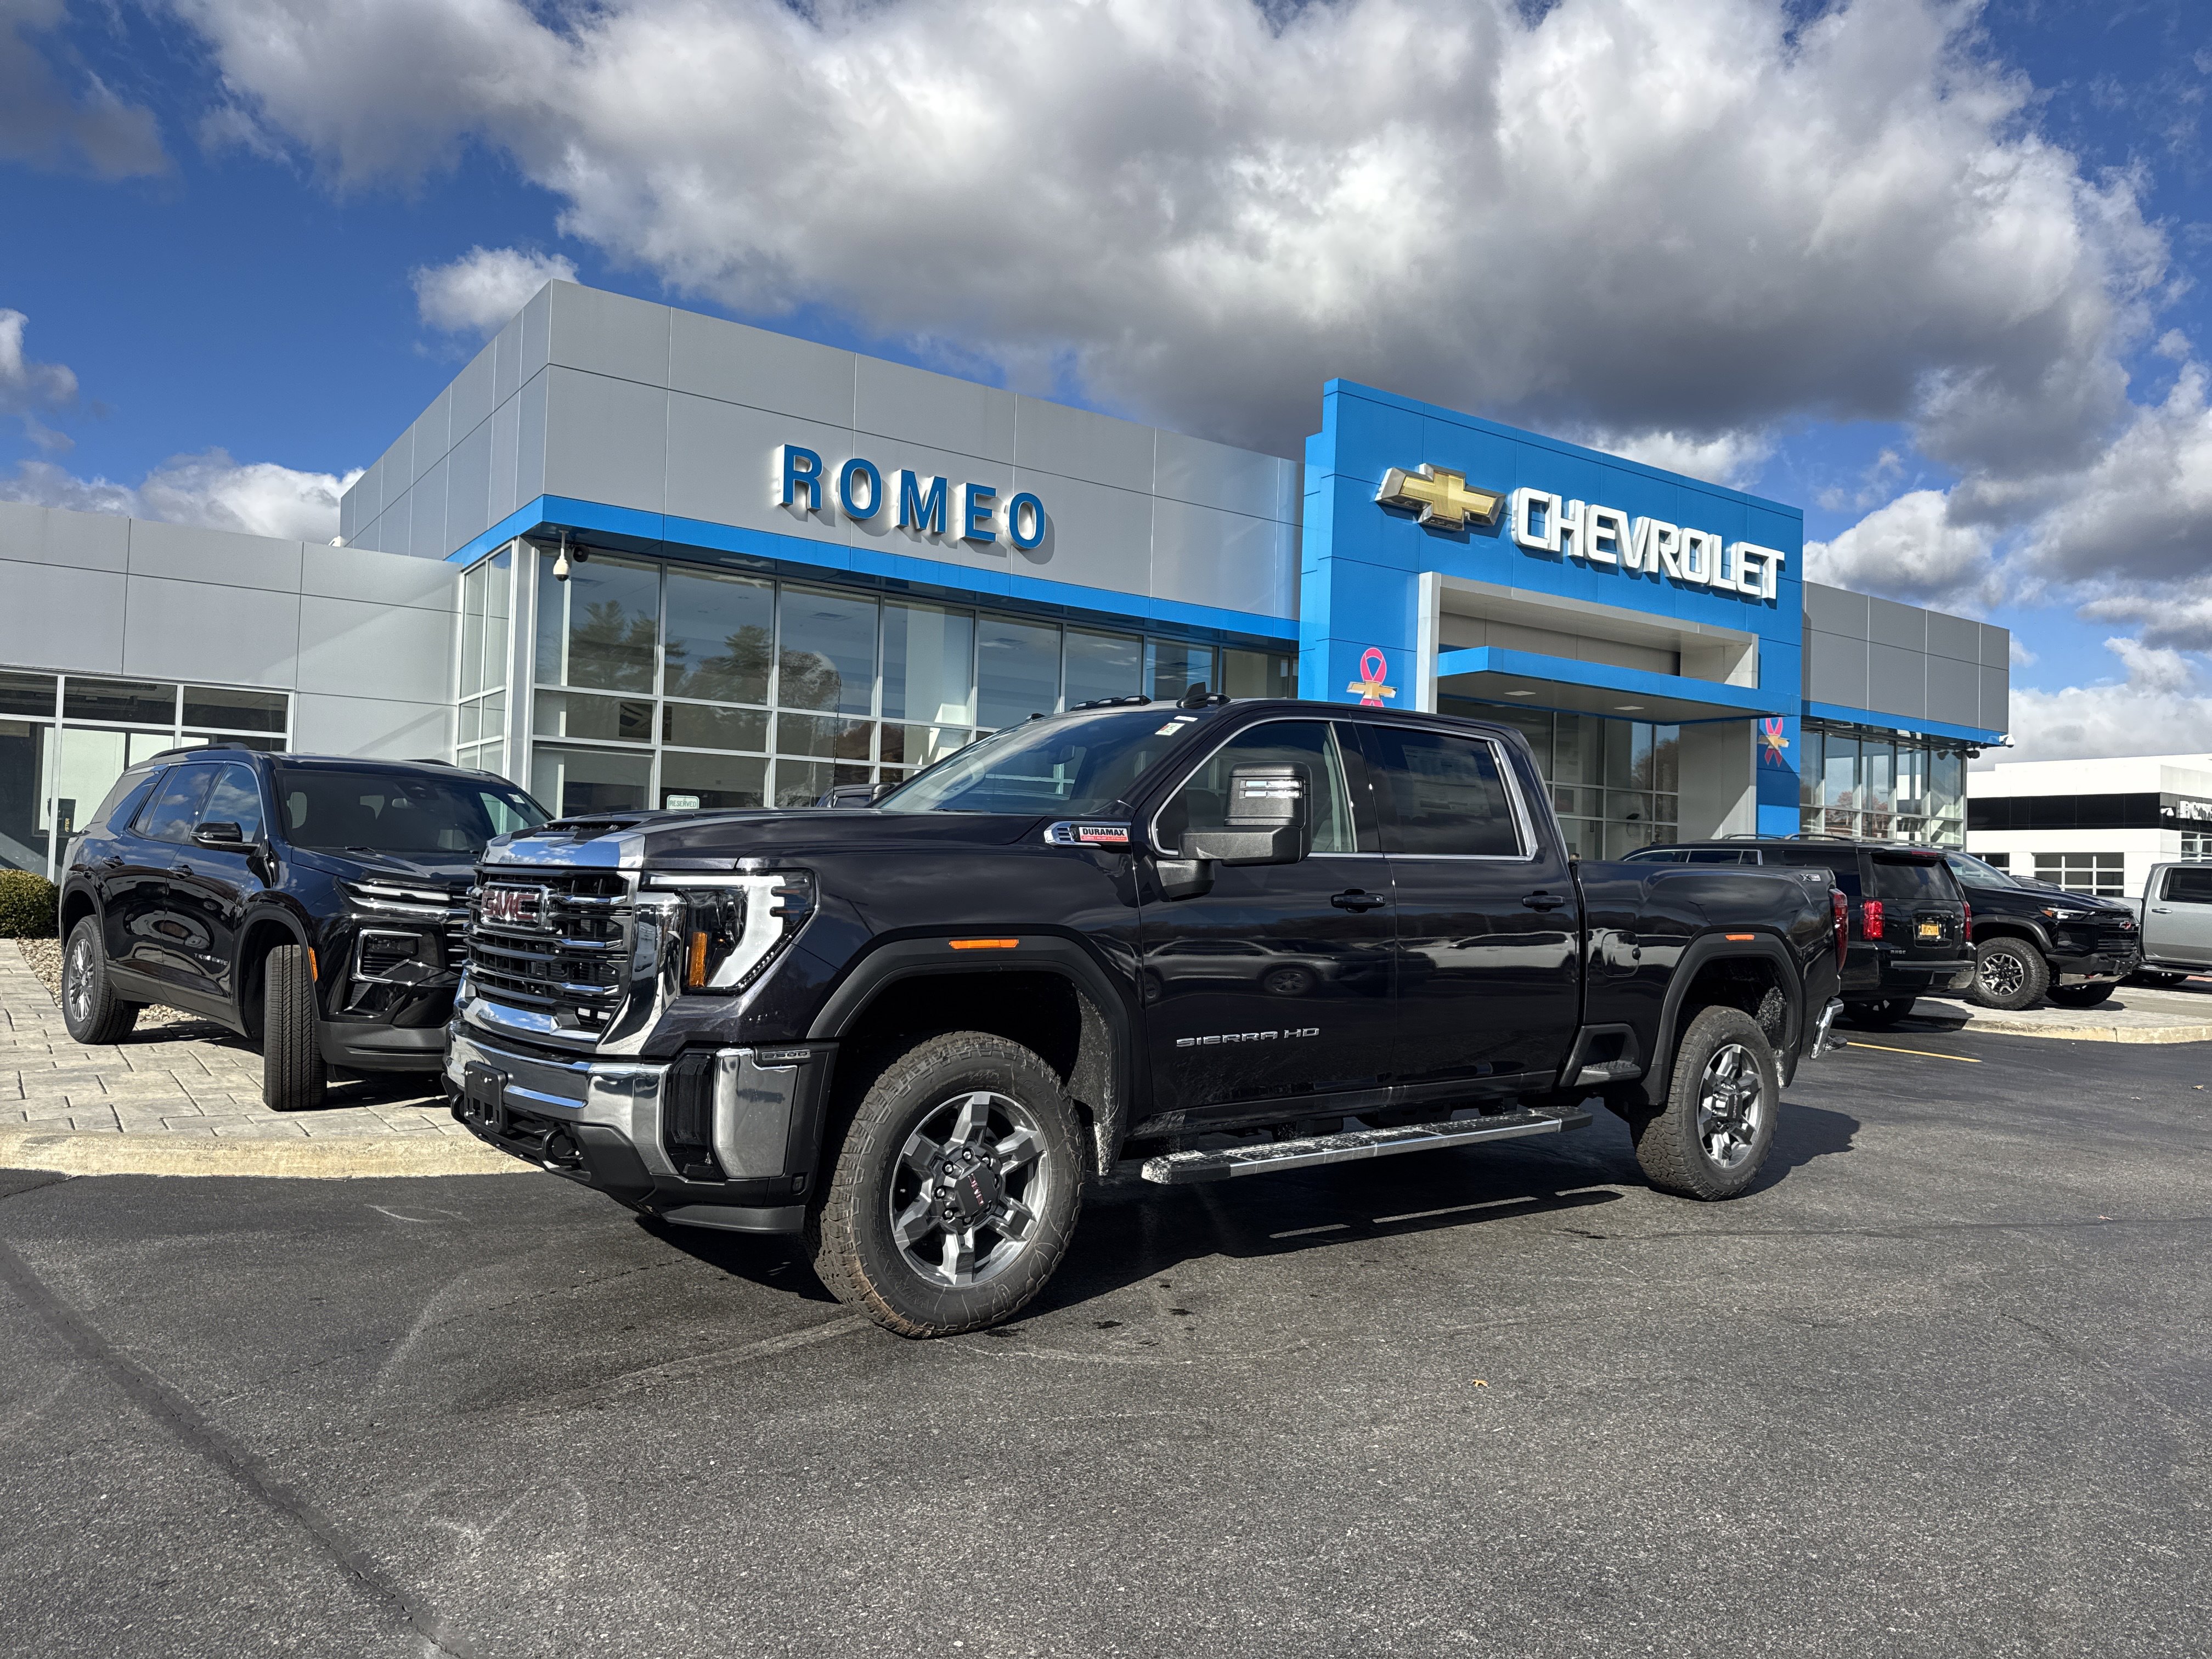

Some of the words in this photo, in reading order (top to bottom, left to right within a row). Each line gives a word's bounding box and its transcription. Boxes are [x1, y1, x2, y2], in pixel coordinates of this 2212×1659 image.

[780, 444, 1046, 549] ROMEO
[1511, 487, 1785, 600] CHEVROLET
[1082, 828, 1125, 836] DURAMAX
[481, 890, 540, 921] GMC
[1176, 1031, 1278, 1047] SIERRA
[1284, 1027, 1320, 1039] HD
[967, 1173, 985, 1206] GMC
